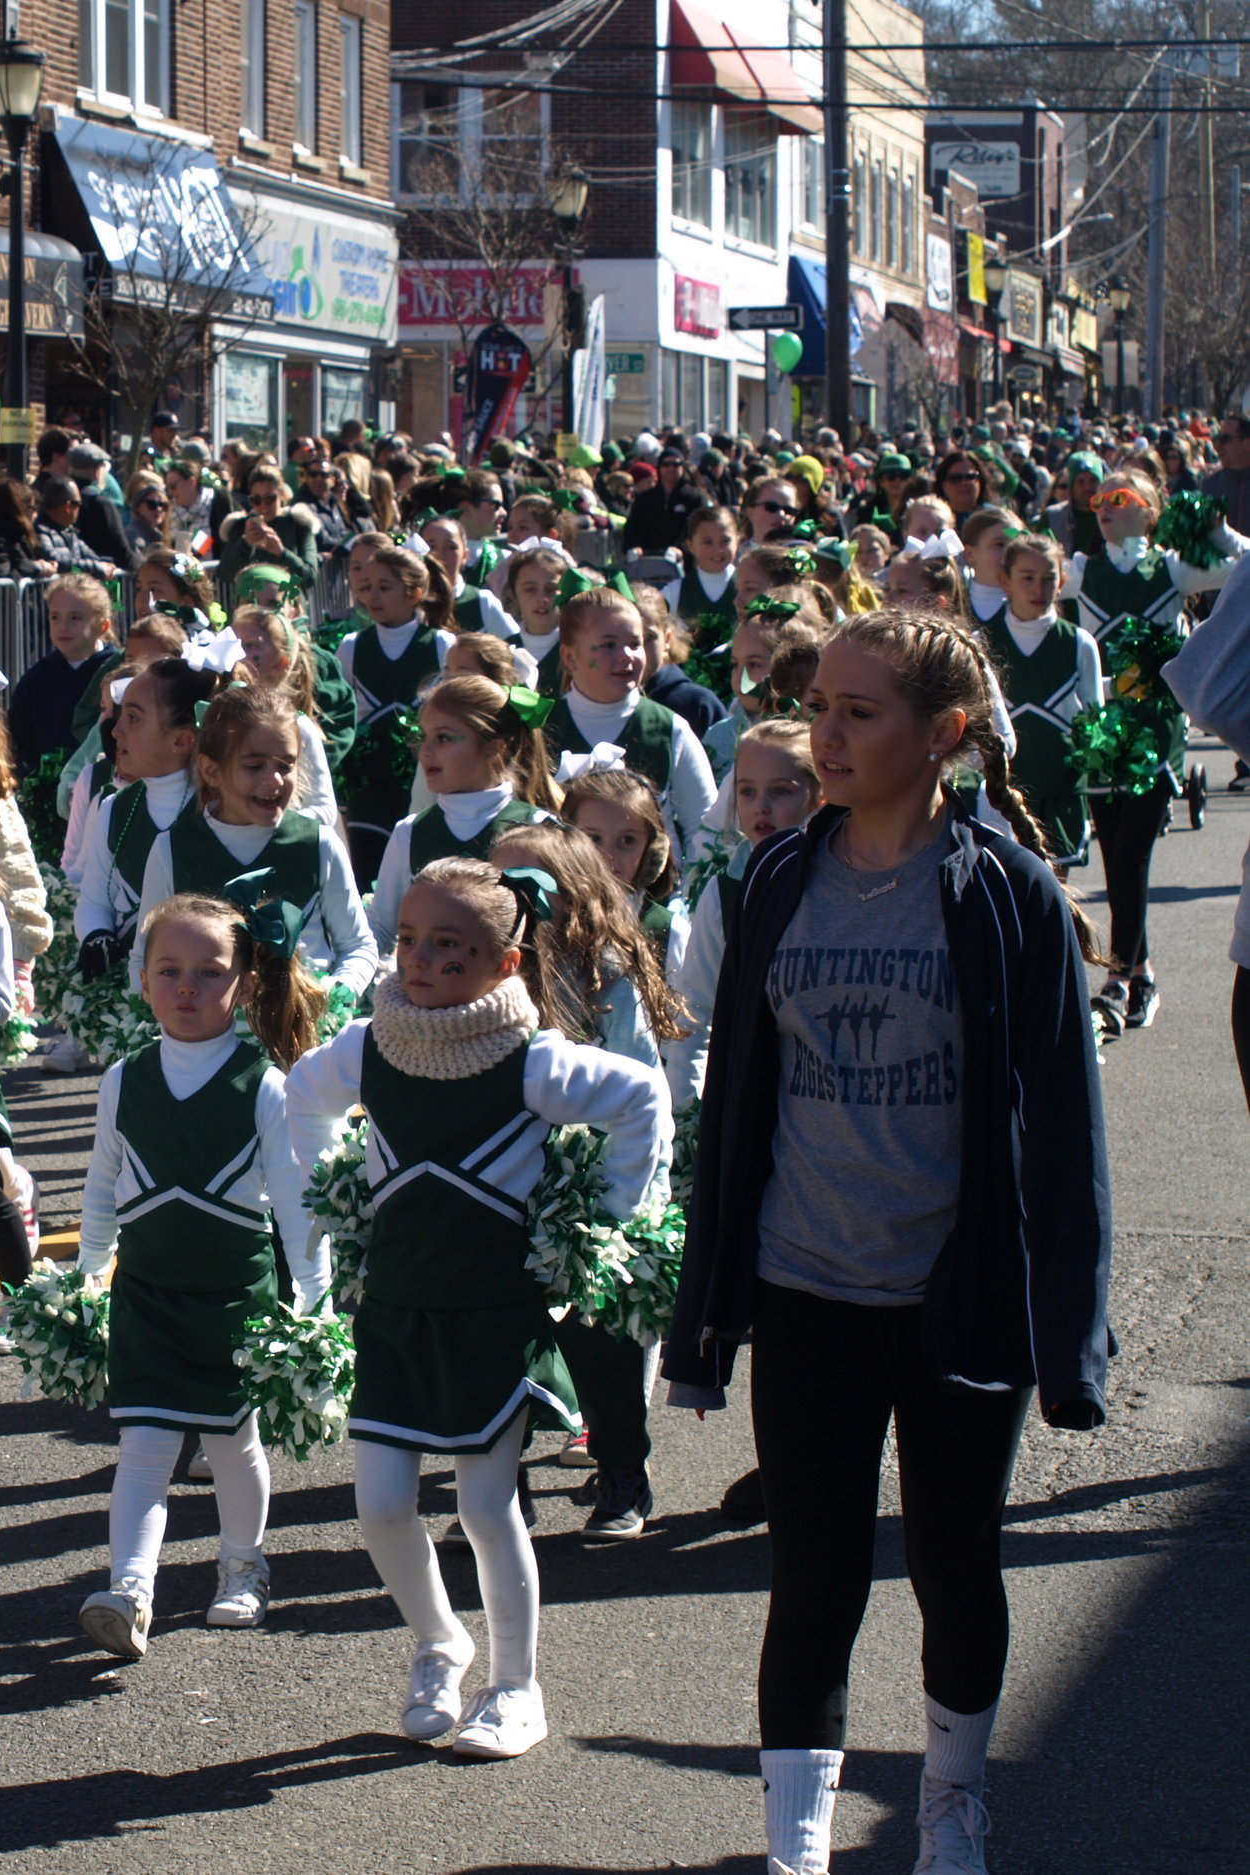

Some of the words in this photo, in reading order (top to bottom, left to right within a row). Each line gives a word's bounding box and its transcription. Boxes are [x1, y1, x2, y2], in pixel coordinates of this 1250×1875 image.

[24, 301, 56, 330] VERN
[400, 275, 544, 319] -Mobile
[769, 947, 955, 1014] HUNTINGTON
